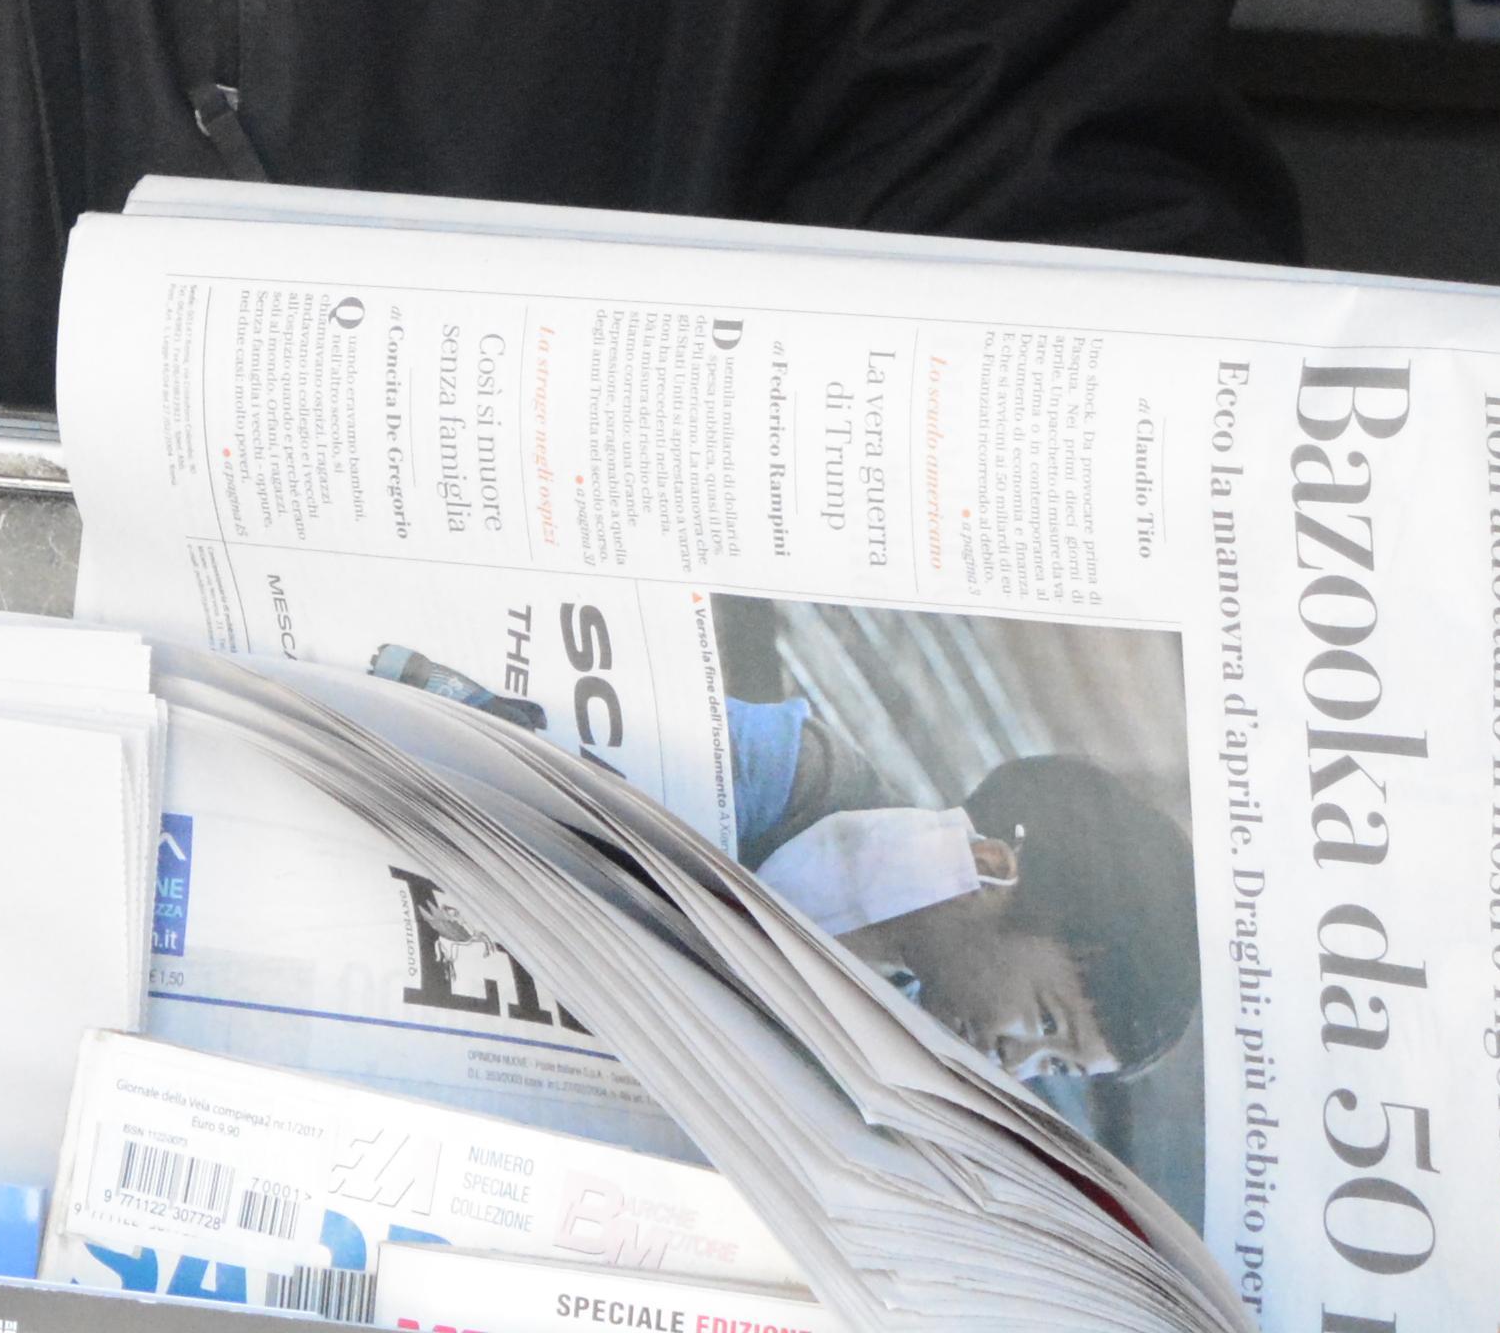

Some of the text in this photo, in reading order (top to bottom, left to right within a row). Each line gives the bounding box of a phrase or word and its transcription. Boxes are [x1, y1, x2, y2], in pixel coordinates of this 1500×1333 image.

[436, 322, 475, 535] senza famiglia
[503, 604, 533, 699] THE
[1289, 356, 1441, 1276] Bazooka da 50
[467, 1144, 535, 1178] NUMERO
[462, 1171, 530, 1204] SPECIALE
[118, 1191, 167, 1218] 771122
[172, 1205, 223, 1231] 307728
[450, 1196, 535, 1234] COLLEZIONE
[555, 1293, 686, 1333] SPECIALE
